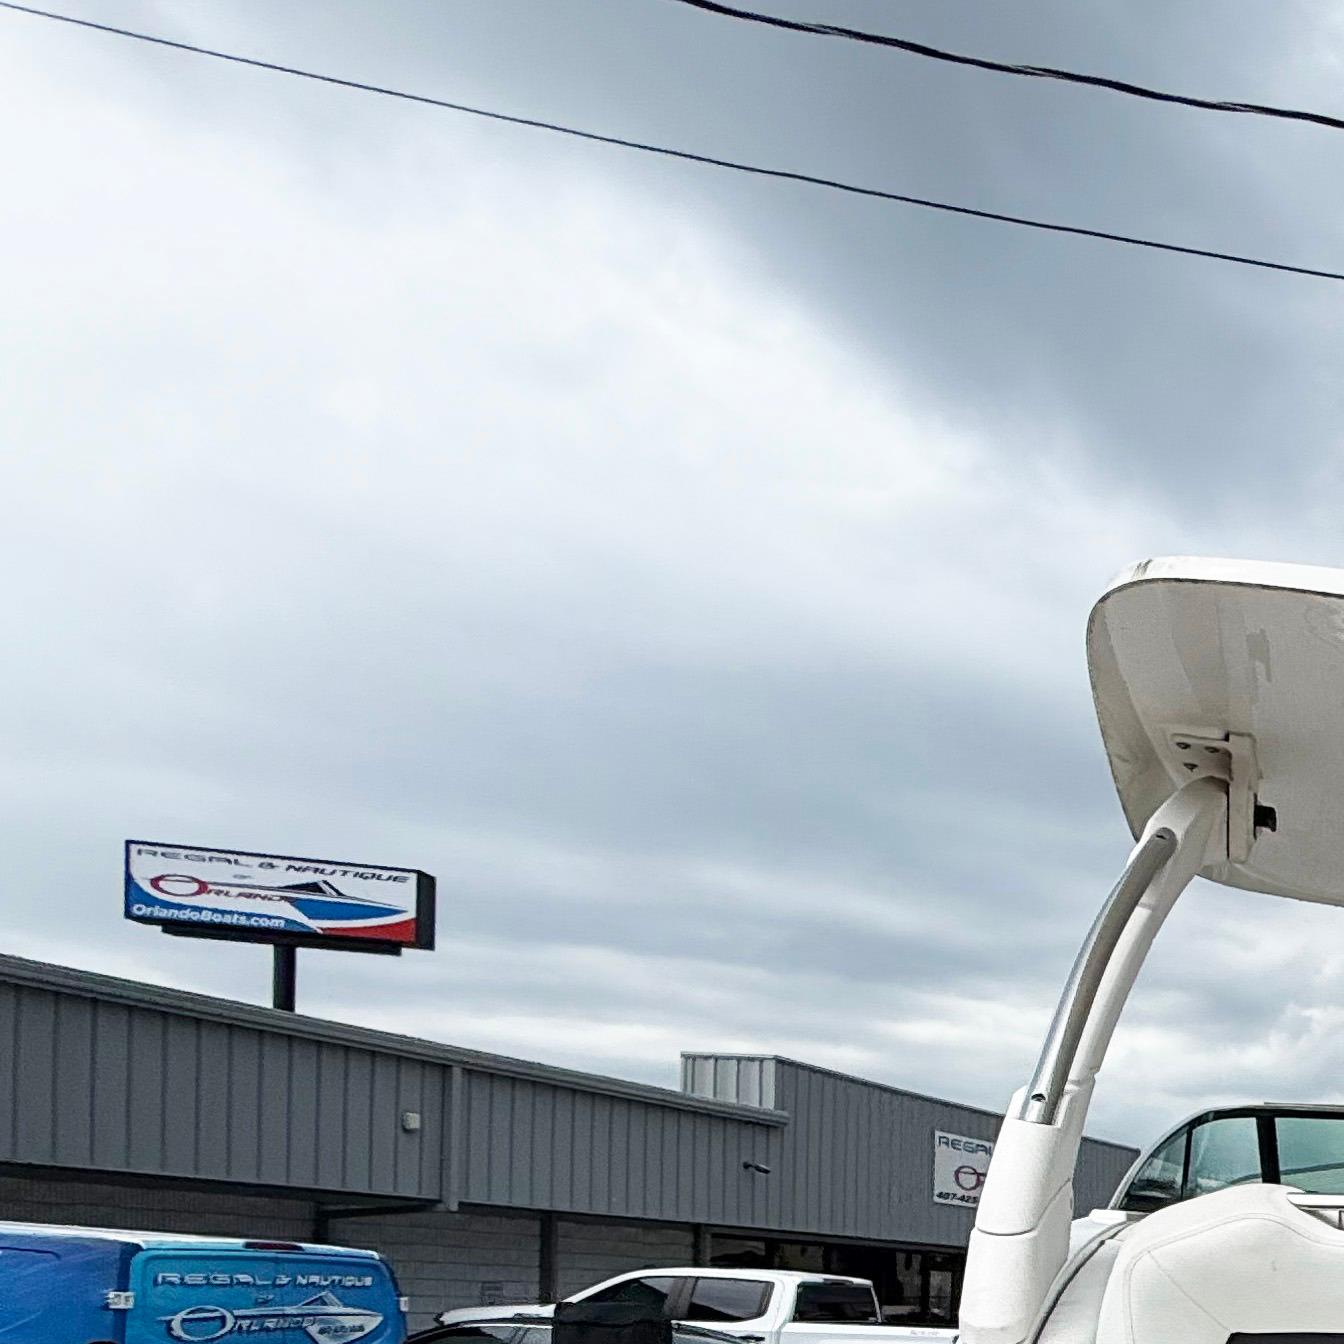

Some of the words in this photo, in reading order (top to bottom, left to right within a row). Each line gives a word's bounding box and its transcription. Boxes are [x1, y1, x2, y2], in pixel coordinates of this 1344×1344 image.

[137, 847, 250, 868] REGAL
[285, 864, 411, 885] NAUTIQUE
[131, 903, 286, 929] OrlandoBoats.com
[157, 1272, 271, 1286] REGAL
[296, 1274, 374, 1287] NAUTIQUE
